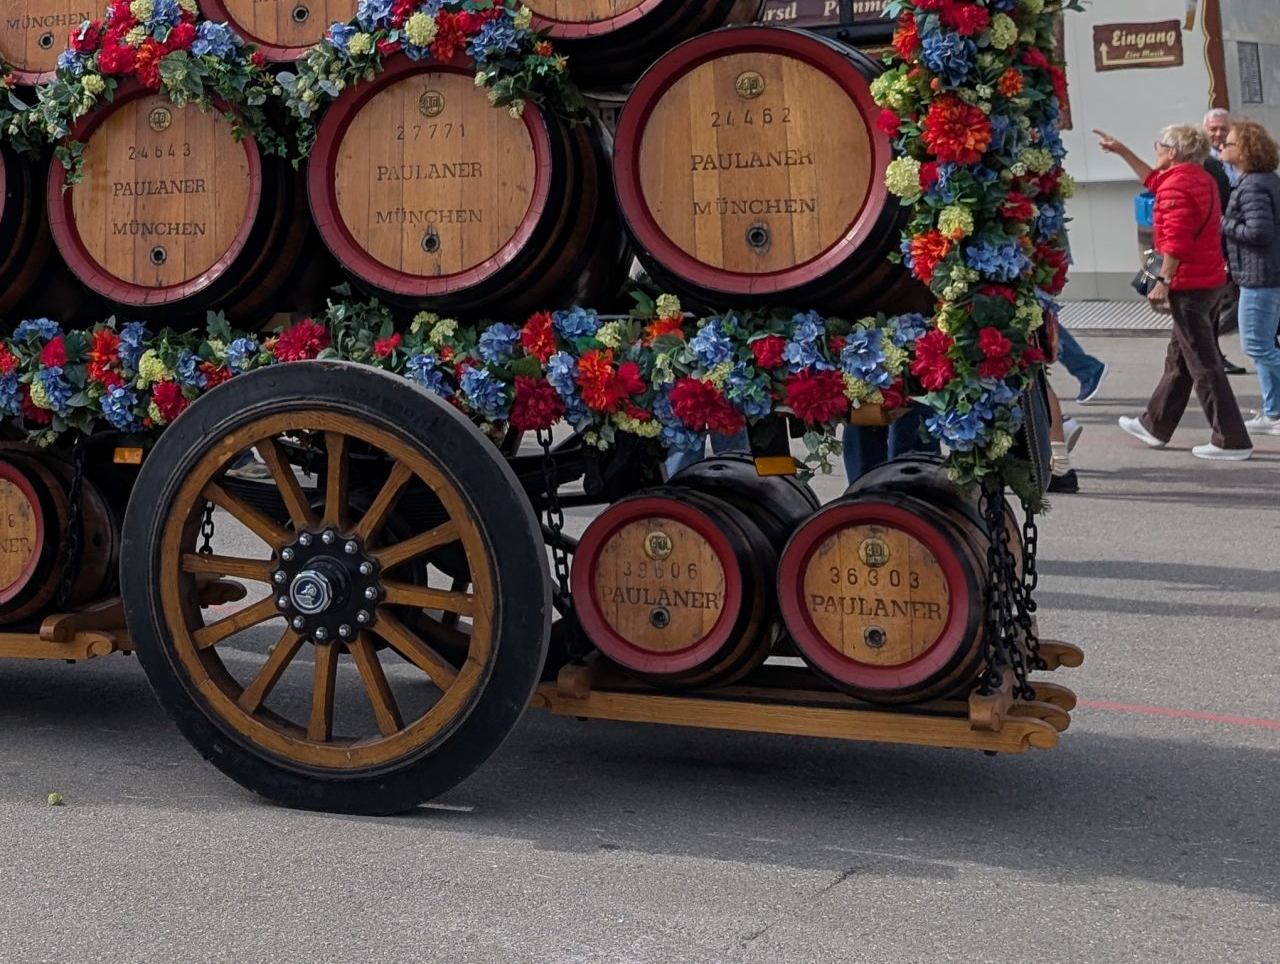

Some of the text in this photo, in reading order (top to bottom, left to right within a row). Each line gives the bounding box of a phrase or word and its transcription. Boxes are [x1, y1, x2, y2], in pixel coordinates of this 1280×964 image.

[6, 11, 90, 30] MÜNCHEN
[1112, 30, 1176, 48] Eingang
[711, 107, 792, 128] 24462
[397, 123, 465, 141] 27771
[690, 149, 814, 171] PAULANER
[377, 162, 483, 181] PAULANER
[113, 178, 206, 197] PAULANER
[376, 207, 483, 224] MÜNCHEN
[692, 197, 817, 215] MÜNCHEN
[112, 219, 207, 236] MÜNCHEN
[829, 566, 920, 589] 36303
[600, 586, 720, 610] PAULANER
[810, 594, 942, 620] PAULANER
